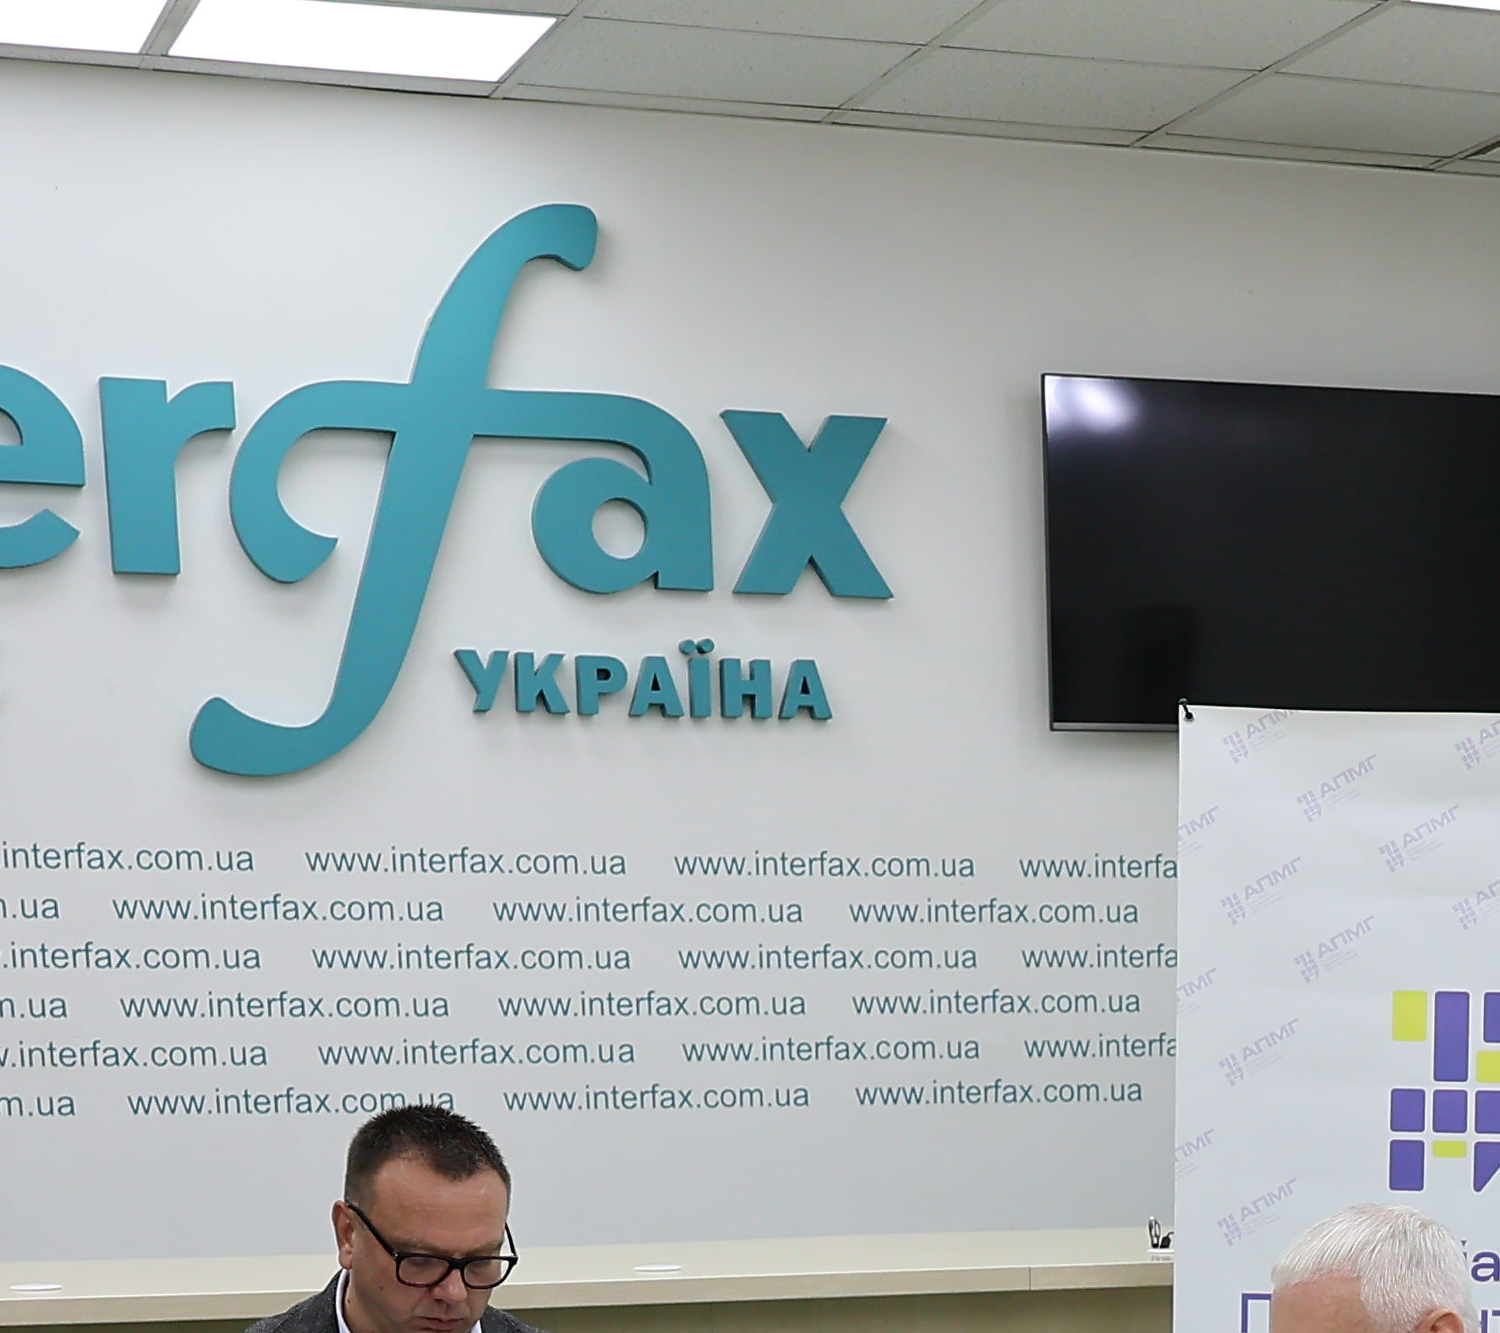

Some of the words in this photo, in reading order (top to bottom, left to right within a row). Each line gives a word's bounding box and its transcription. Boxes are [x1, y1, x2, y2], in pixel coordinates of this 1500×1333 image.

[454, 637, 833, 721] УКРАЇНА
[1318, 753, 1377, 798] АПМГ
[1178, 806, 1219, 841] ПМГ
[1402, 804, 1460, 848] АПМГ
[305, 845, 626, 875] www.interfax.com.ua
[674, 849, 975, 878] www.interfax.com.ua
[1019, 853, 1178, 879] www.interfa
[1244, 856, 1301, 900] АПМГ
[112, 892, 444, 922] www.interfax.com.ua
[492, 896, 803, 923] www.interfax.com.ua
[849, 897, 1138, 924] www.interfax.com.ua
[1317, 915, 1374, 958] АПМГ
[312, 942, 631, 970] www.interfax.com.ua
[678, 943, 977, 970] www.interfax.com.ua
[1021, 943, 1178, 968] www.interfa
[1177, 968, 1217, 1002] ПМГ
[119, 990, 449, 1018] www.interfax.com.ua
[498, 990, 806, 1018] www.interfax.com.ua
[852, 988, 1140, 1015] www.interfax.com.ua
[318, 1037, 635, 1066] www.interfax.com.ua
[682, 1035, 980, 1062] www.interfax.com.ua
[1024, 1033, 1176, 1058] www.interfa
[1242, 1018, 1299, 1062] АПМГ
[503, 1083, 809, 1112] www.interfax.com.ua
[855, 1078, 1142, 1106] www.interfax.com.ua
[1240, 1178, 1296, 1222] АПМГ
